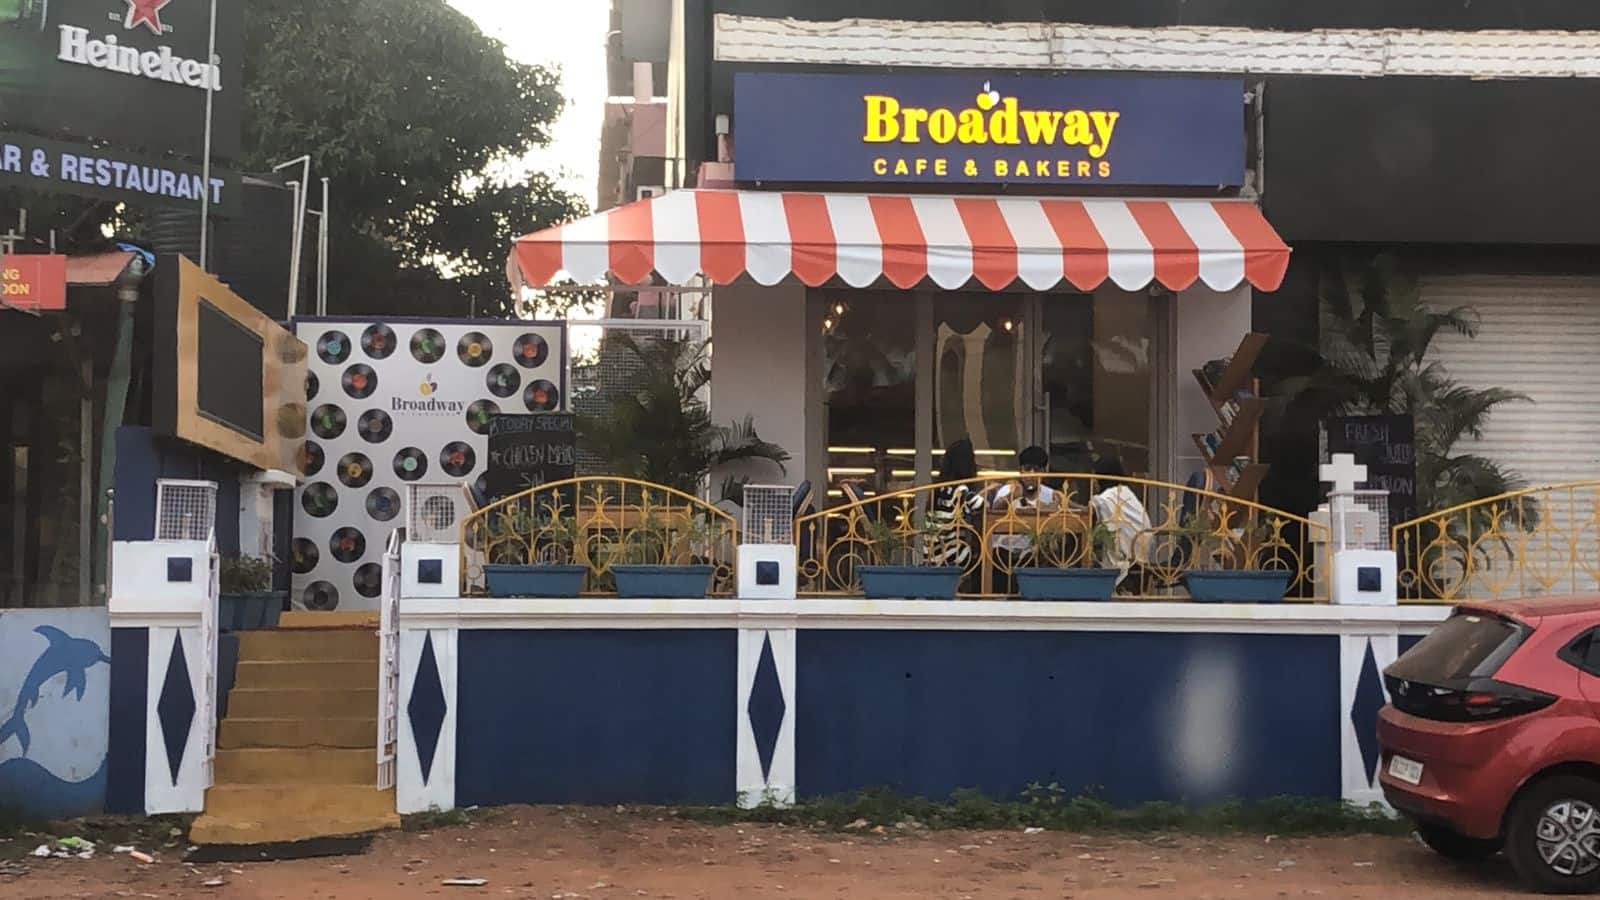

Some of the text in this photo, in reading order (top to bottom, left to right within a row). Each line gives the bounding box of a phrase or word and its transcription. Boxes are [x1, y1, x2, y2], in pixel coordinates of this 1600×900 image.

[57, 24, 223, 92] Heineken
[863, 95, 1120, 159] Broadway
[0, 143, 225, 204] R & RESTAURANT
[873, 158, 1112, 178] CAFE & BAKERS
[391, 396, 465, 415] Broadway
